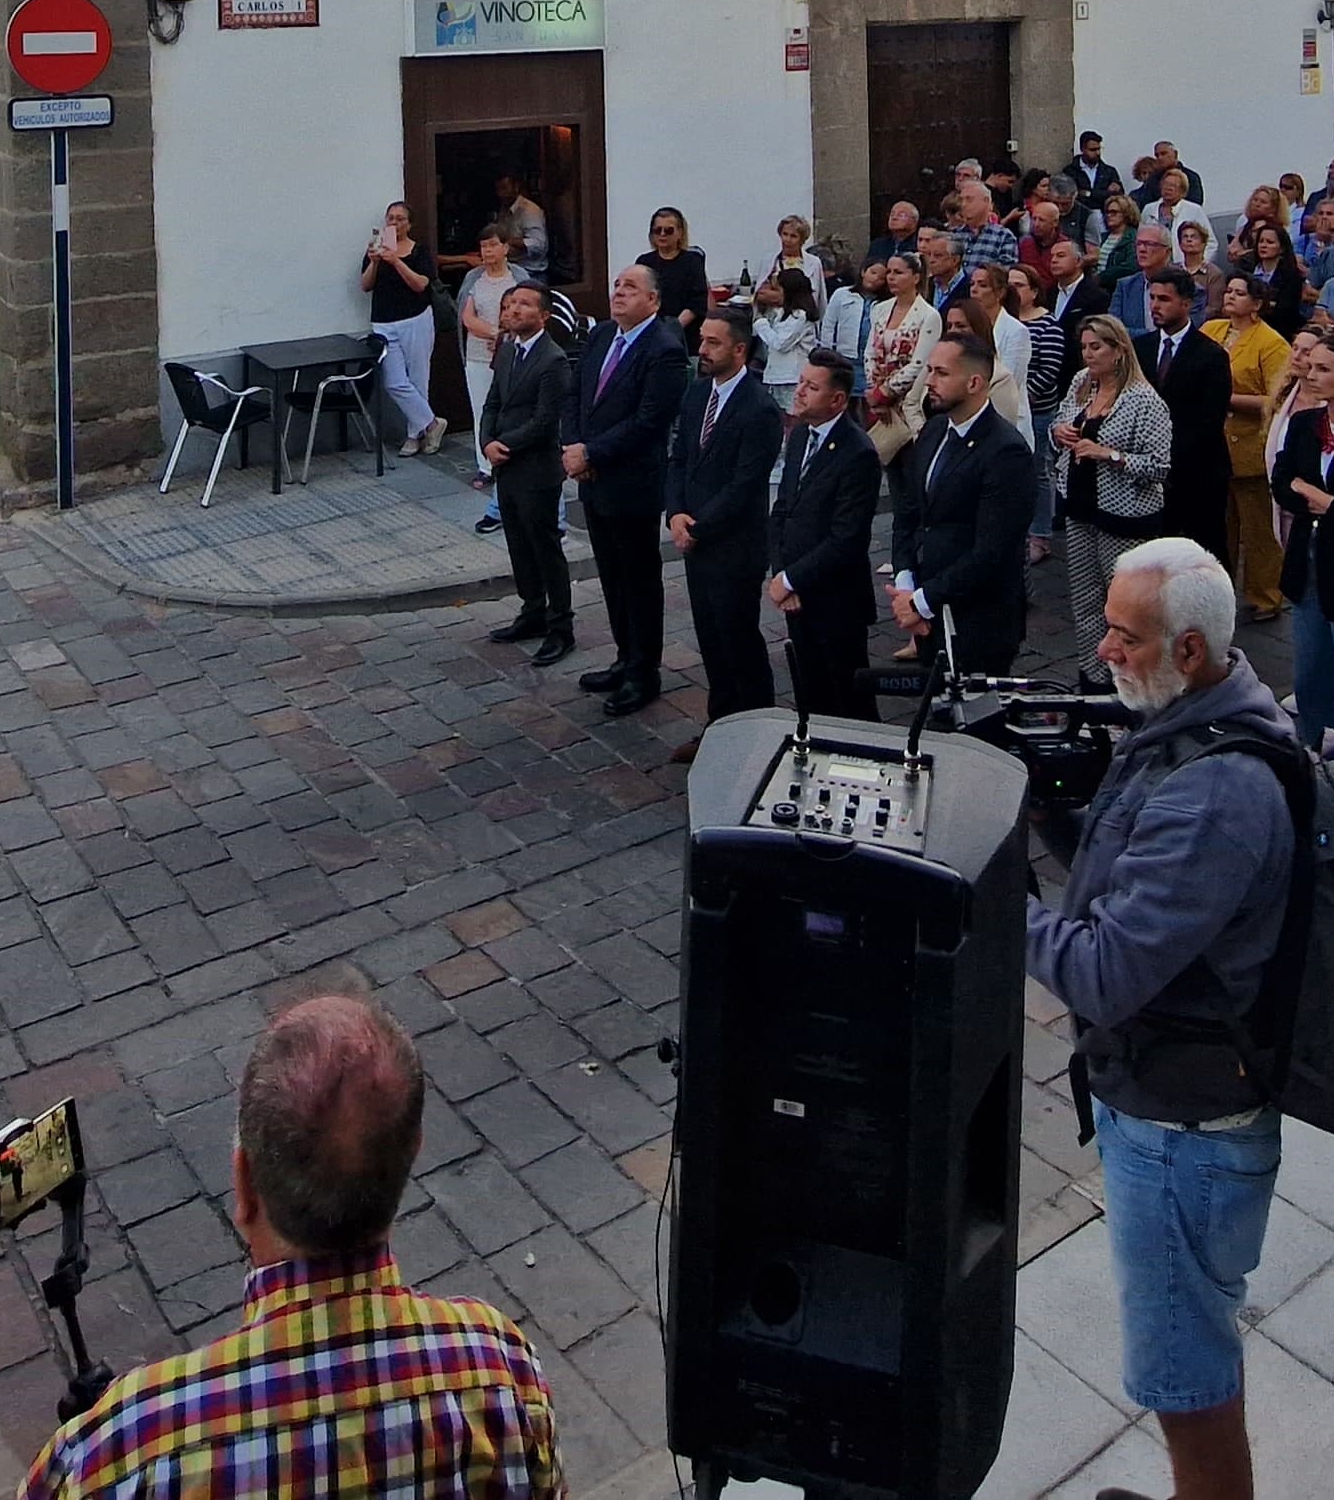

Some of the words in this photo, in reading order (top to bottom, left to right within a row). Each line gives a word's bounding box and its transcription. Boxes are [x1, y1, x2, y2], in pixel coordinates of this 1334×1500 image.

[237, 0, 285, 12] CARLOS
[480, 0, 587, 24] VINOTECA
[40, 101, 82, 113] EXCEPTO
[14, 114, 56, 126] VEHICULOS
[58, 110, 109, 124] AUTORIZADOS
